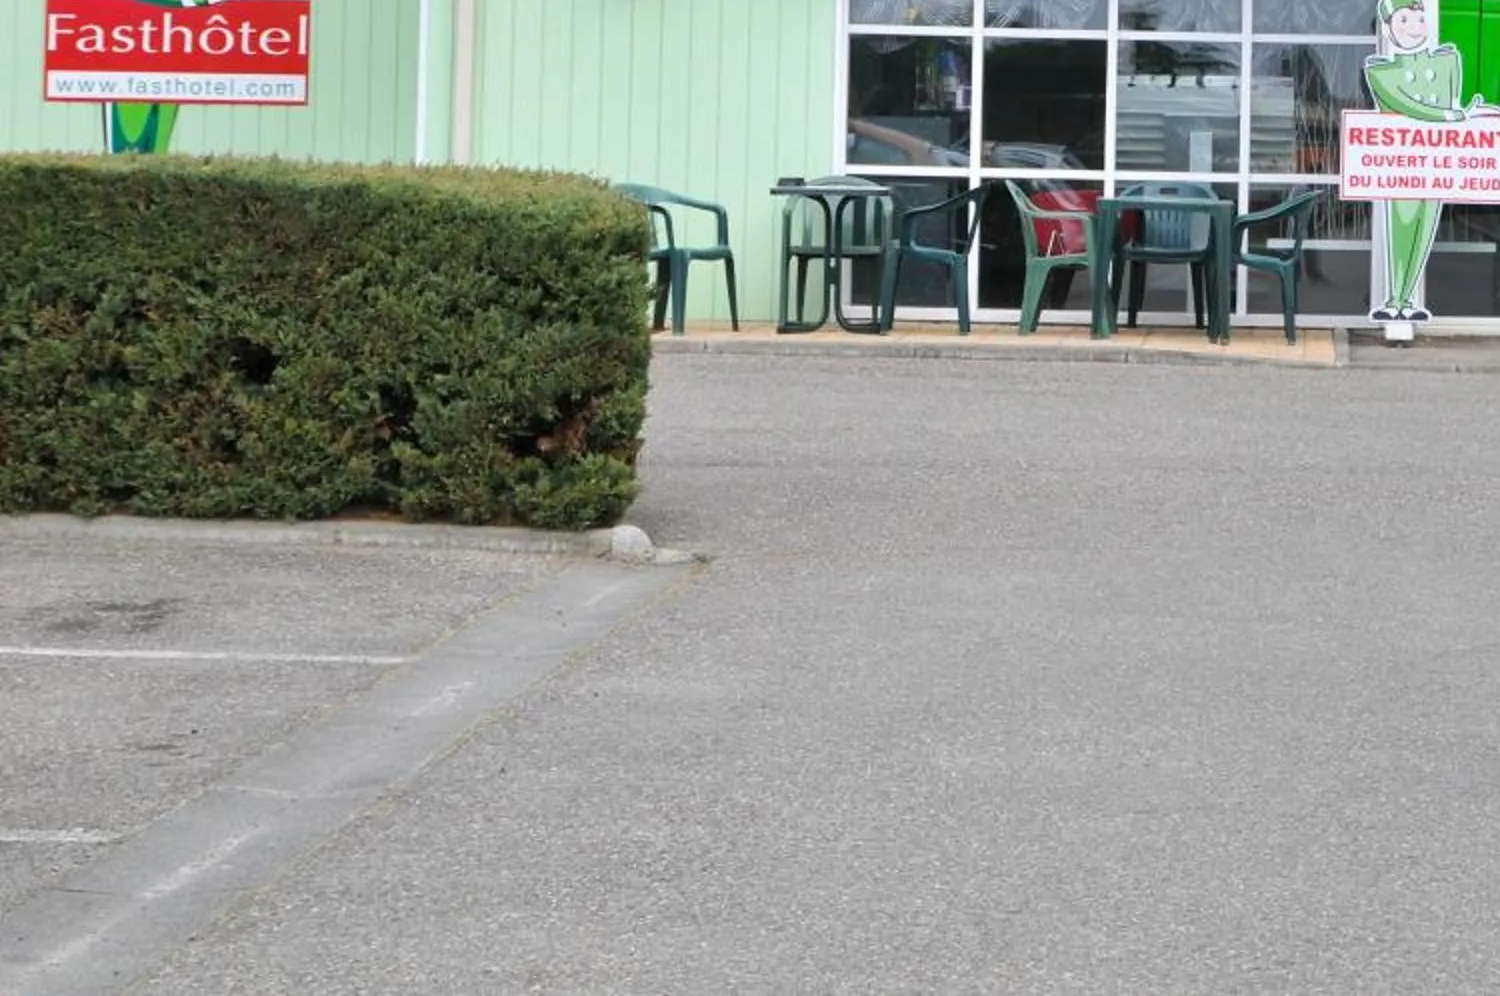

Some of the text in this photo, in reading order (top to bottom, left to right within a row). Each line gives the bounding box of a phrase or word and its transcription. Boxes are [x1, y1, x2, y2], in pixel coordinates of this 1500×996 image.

[47, 12, 308, 55] Fasthôtel
[55, 76, 296, 97] www.fasthotel.com
[1361, 155, 1497, 170] OUVERT LE SOIR
[1349, 175, 1372, 187] DU
[1377, 176, 1427, 188] LUNDI
[1431, 177, 1454, 189] AU
